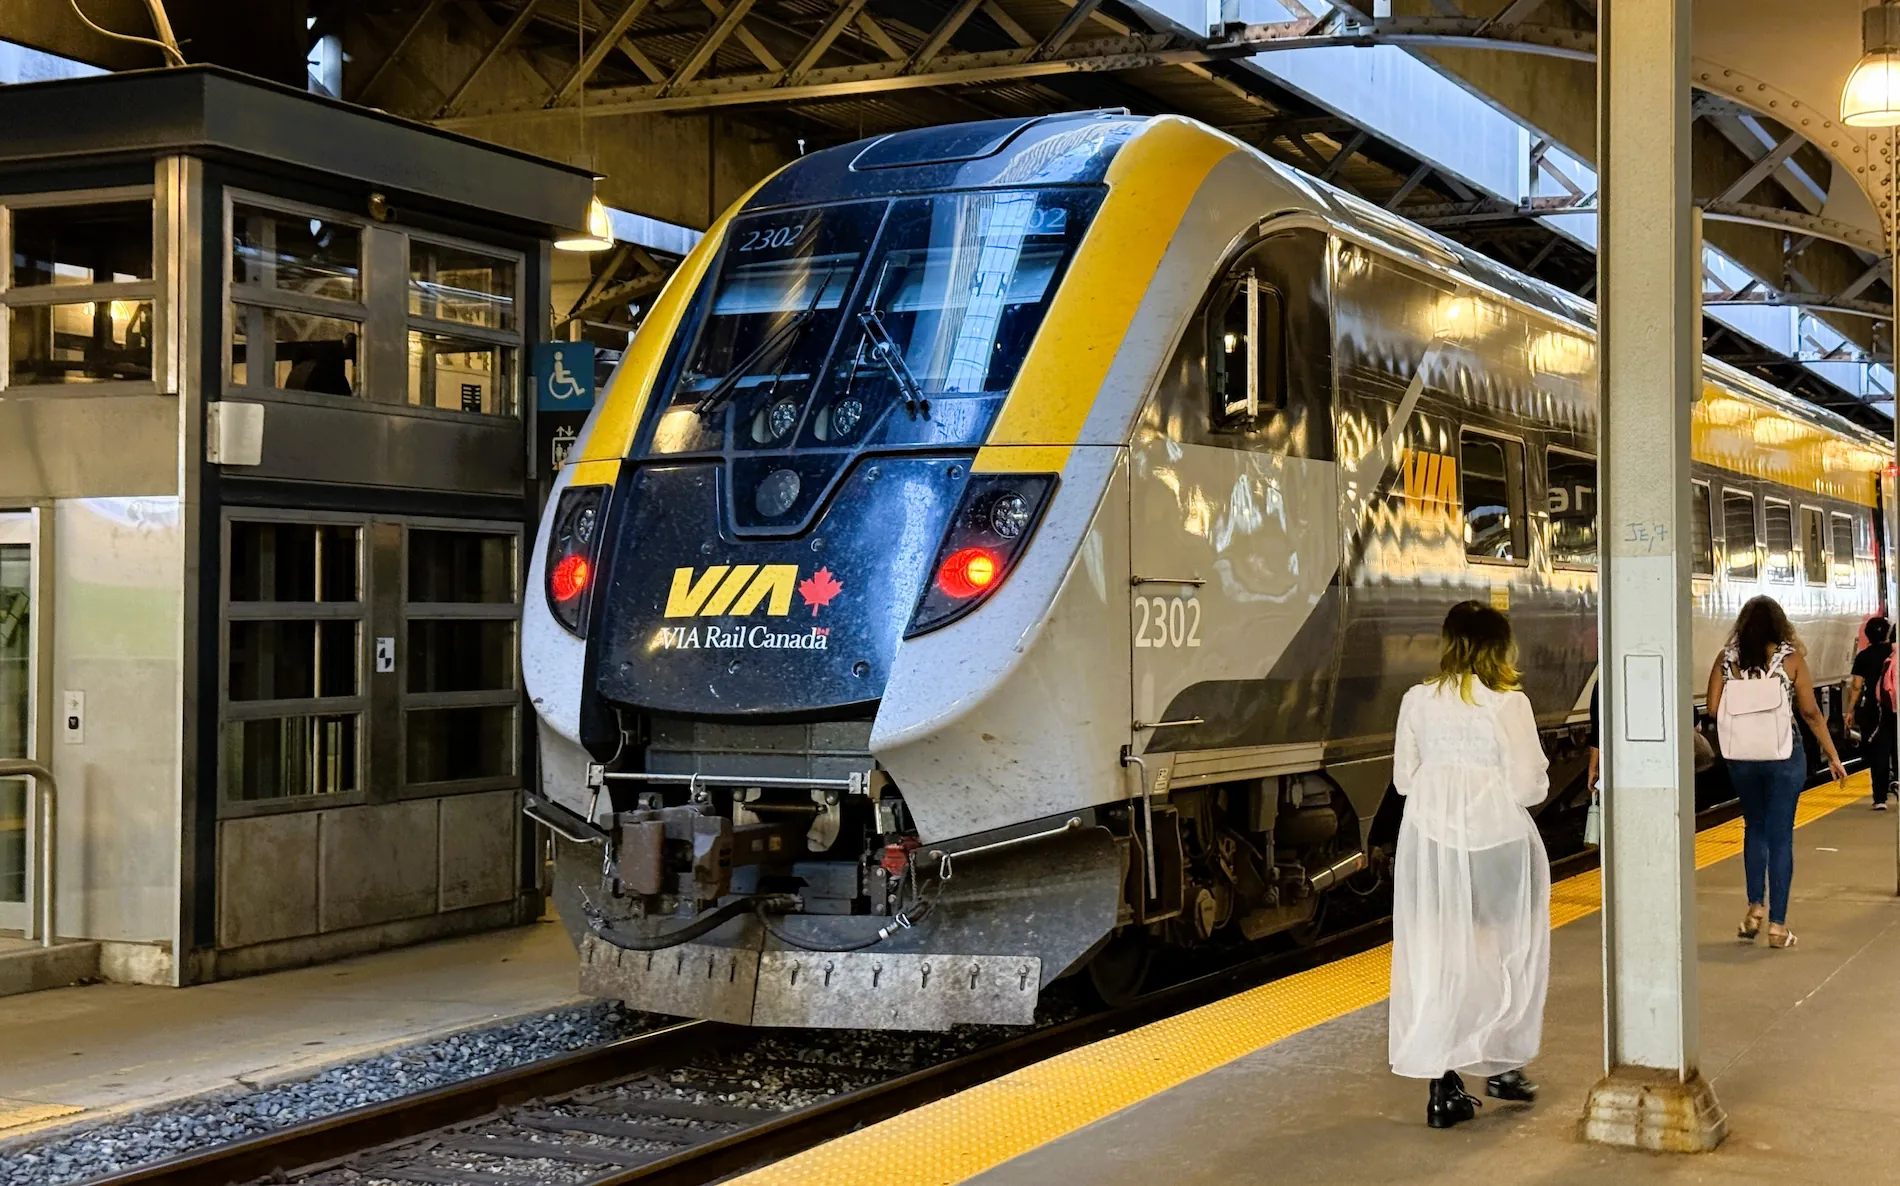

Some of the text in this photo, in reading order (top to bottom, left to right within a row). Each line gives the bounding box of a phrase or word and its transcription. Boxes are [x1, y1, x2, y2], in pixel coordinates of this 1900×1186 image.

[739, 225, 804, 251] 2302
[1403, 448, 1458, 525] VIA
[664, 564, 799, 618] VIA
[659, 625, 828, 650] VIA Rail Canada
[1135, 596, 1201, 648] 2302
